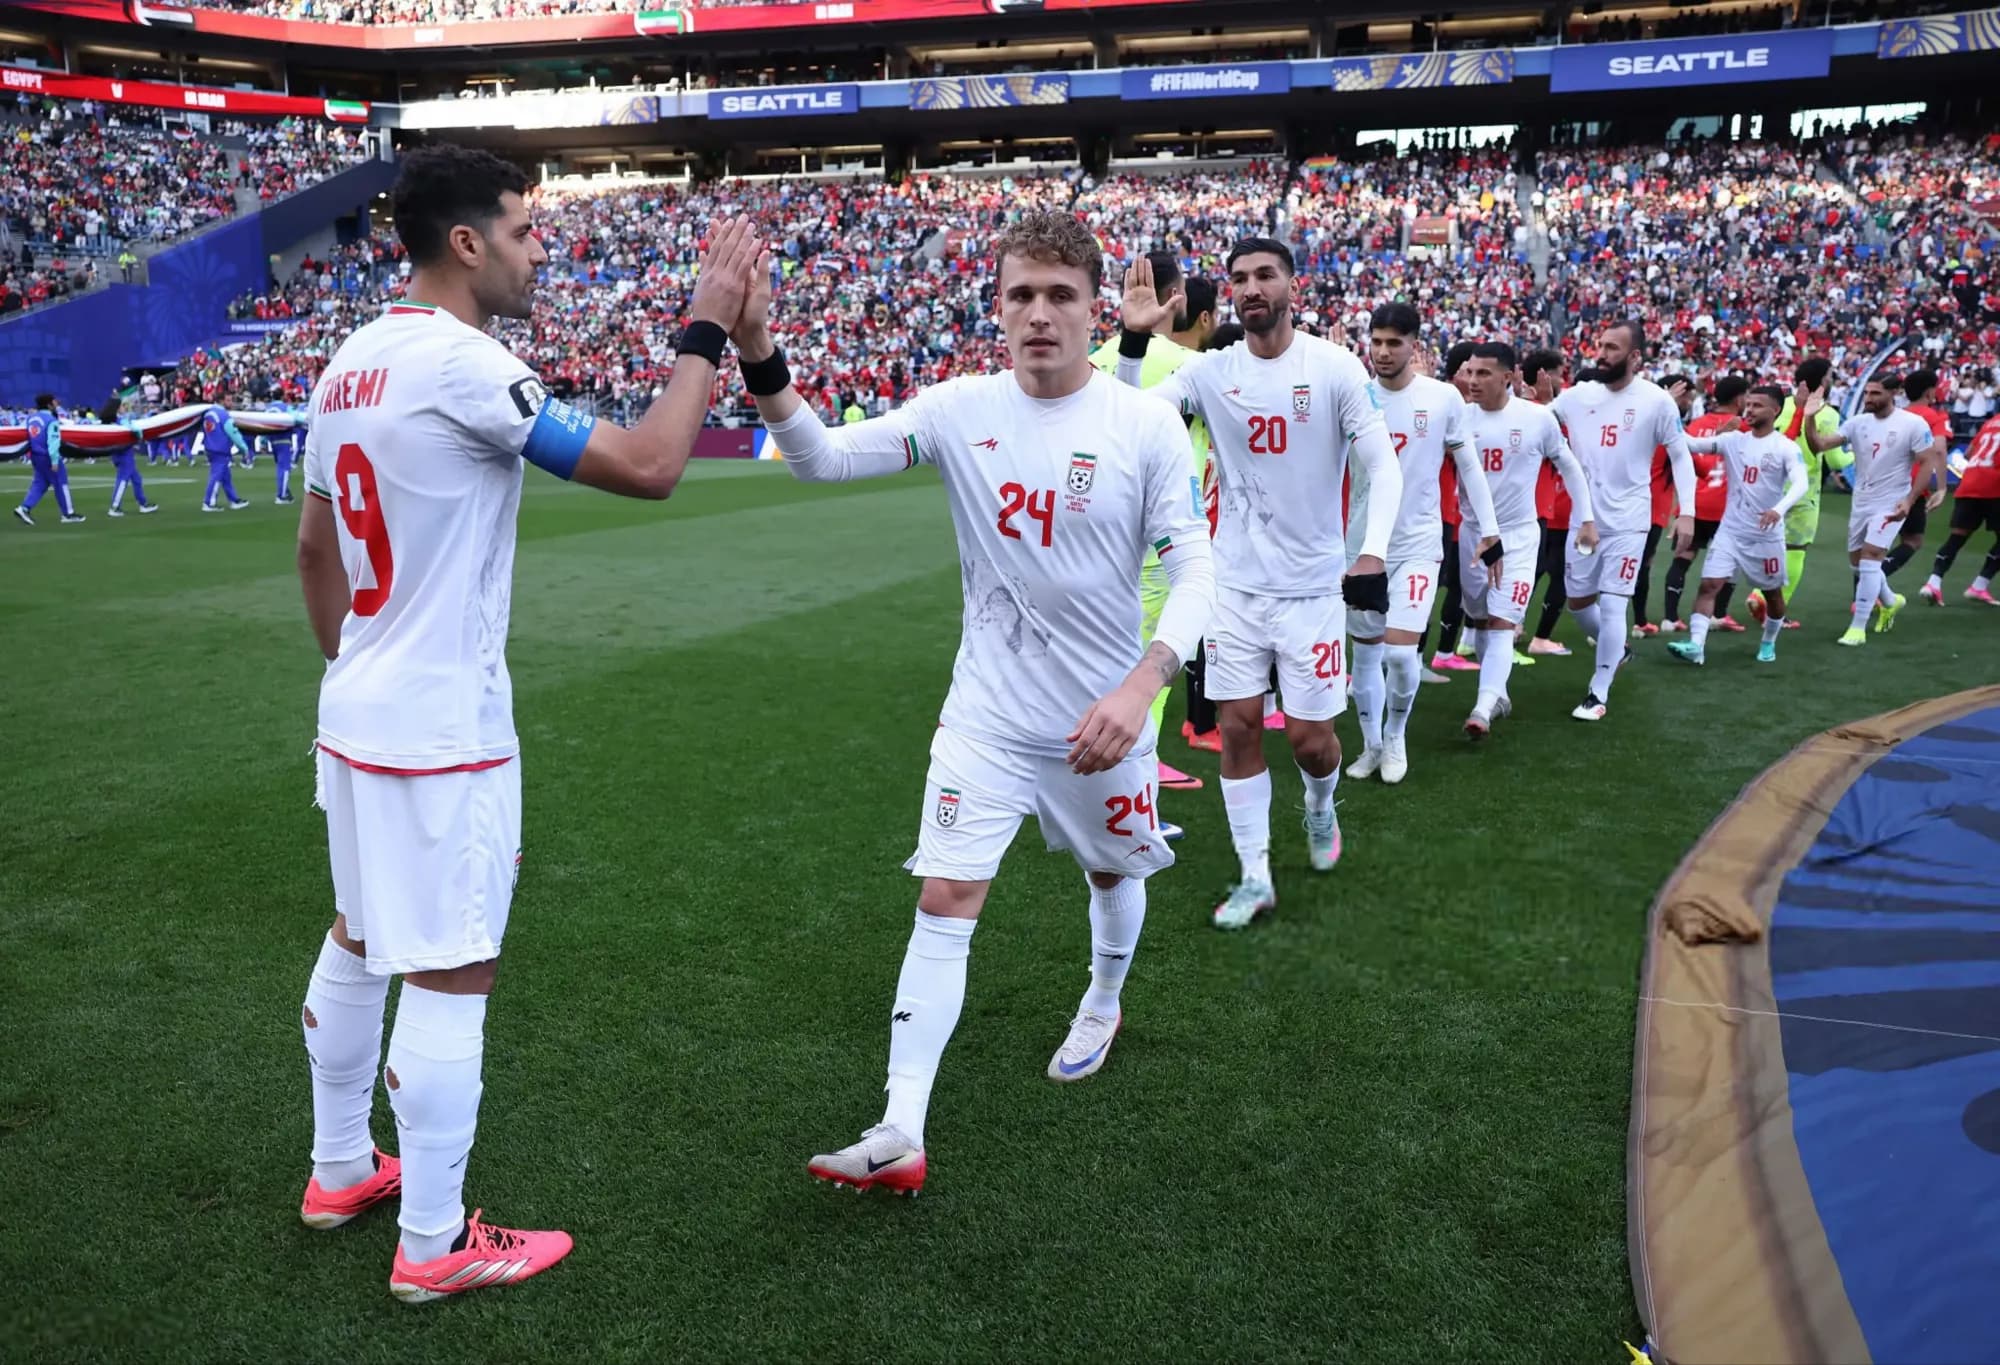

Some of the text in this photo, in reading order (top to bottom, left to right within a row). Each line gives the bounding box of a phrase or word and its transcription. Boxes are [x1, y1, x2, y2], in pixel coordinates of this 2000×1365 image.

[1608, 48, 1769, 76] SEATTLE
[3, 70, 43, 89] EGYPT
[1151, 70, 1259, 91] #FIFAWorldCup
[722, 91, 842, 112] SEATTLE
[319, 368, 389, 415] TAREMI
[1248, 415, 1287, 454] 20
[1600, 425, 1618, 447] 15
[1482, 448, 1504, 472] 18
[1872, 443, 1880, 459] 7
[1967, 431, 2000, 468] 21
[1743, 464, 1758, 484] 10
[997, 482, 1056, 548] 24
[336, 443, 394, 617] 9
[1619, 557, 1638, 580] 15
[1763, 558, 1779, 575] 10
[1407, 574, 1429, 602] 17
[1512, 580, 1530, 605] 18
[1311, 639, 1341, 680] 20
[1105, 782, 1155, 837] 24
